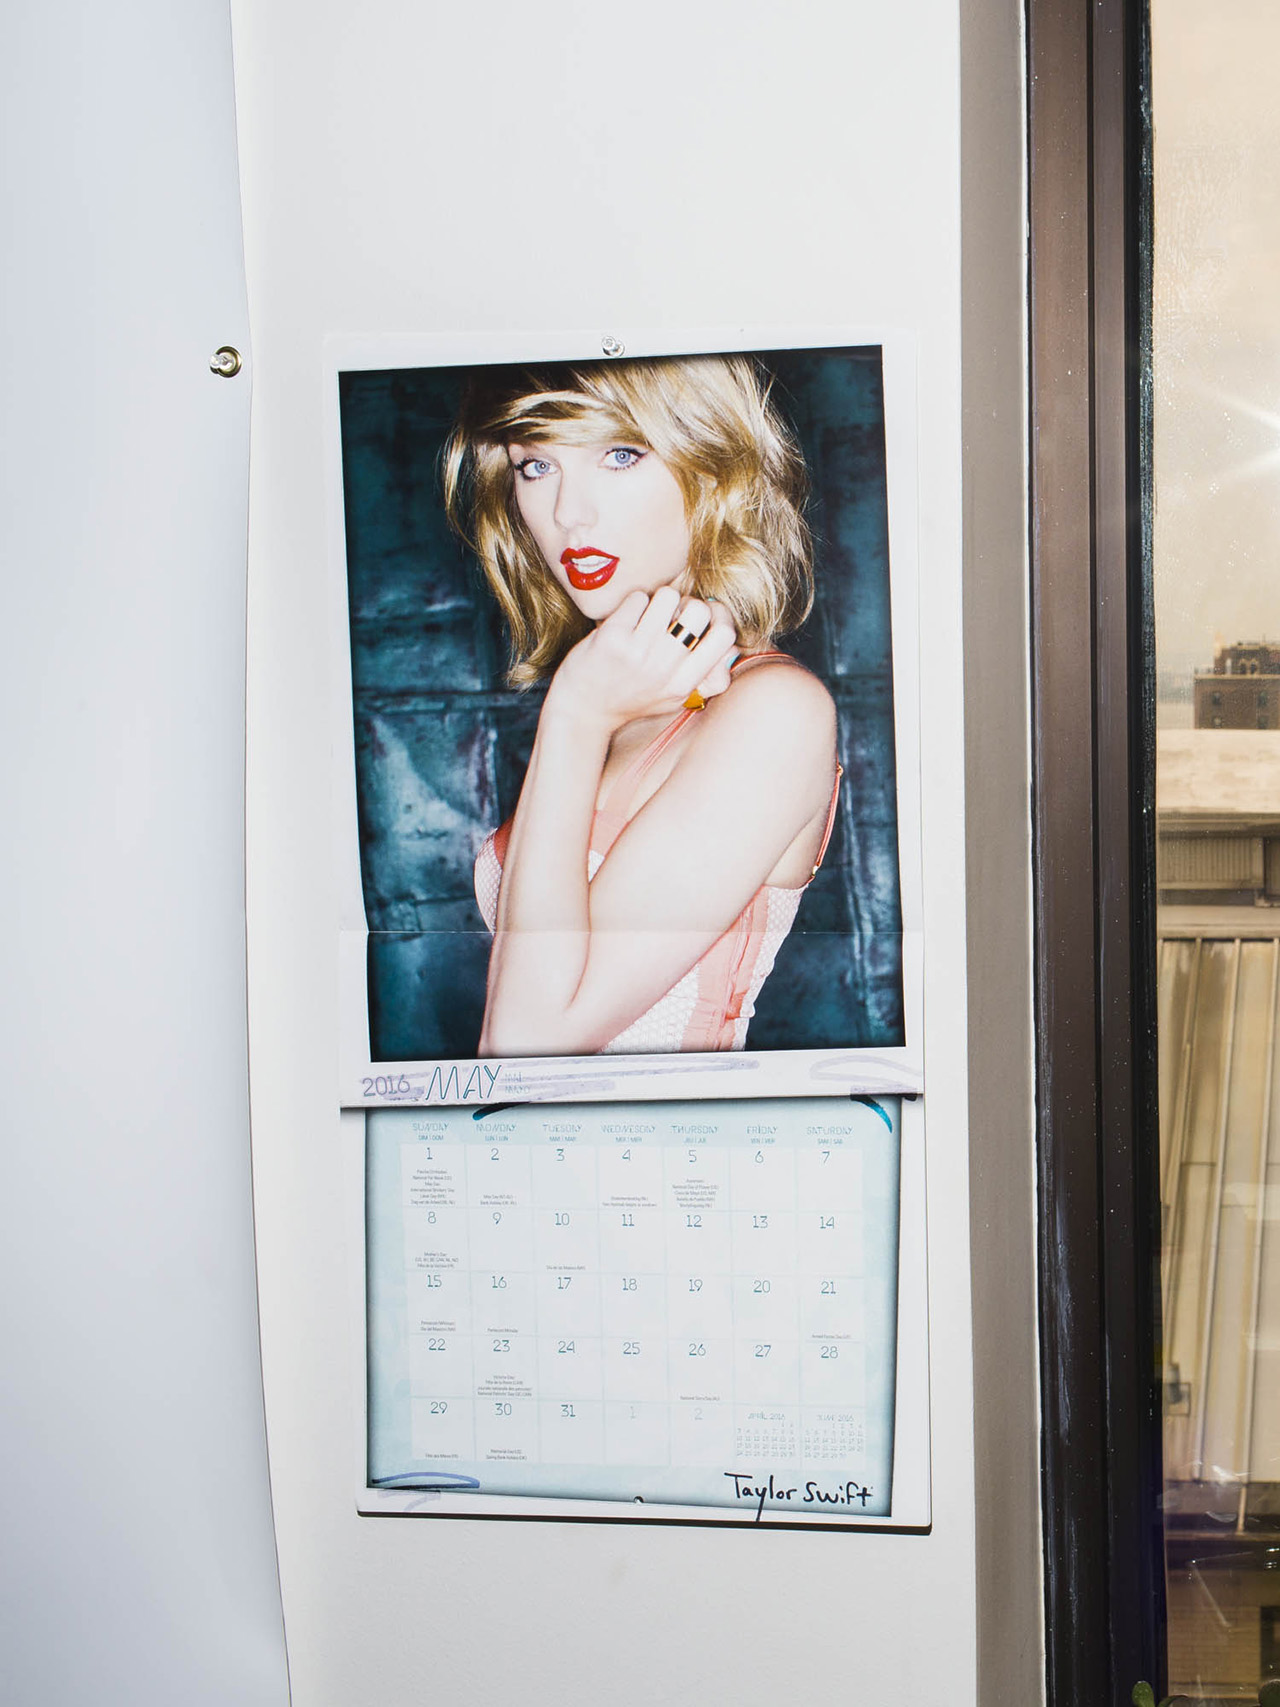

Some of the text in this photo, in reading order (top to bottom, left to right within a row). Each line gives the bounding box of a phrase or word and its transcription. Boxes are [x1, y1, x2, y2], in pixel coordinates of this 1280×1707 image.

[362, 1064, 502, 1100] 2016 MAY
[412, 1122, 854, 1135] SUNDAY MONDAY TUESDAY WEDNESDAY THURSDAY FRIDAY SATURDAY
[427, 1147, 830, 1163] 1 2 3 4 5 6 7
[428, 1212, 835, 1229] 8 9 10 11 12 13 14
[427, 1275, 836, 1294] 15 16 17 18 19 20 21
[429, 1338, 838, 1359] 22 23 24 25 26 27 28
[431, 1402, 447, 1414] 29
[495, 1403, 512, 1416] 30
[561, 1404, 576, 1417] 31
[695, 1408, 702, 1420] 2
[724, 1472, 874, 1522] Taylor Swift
